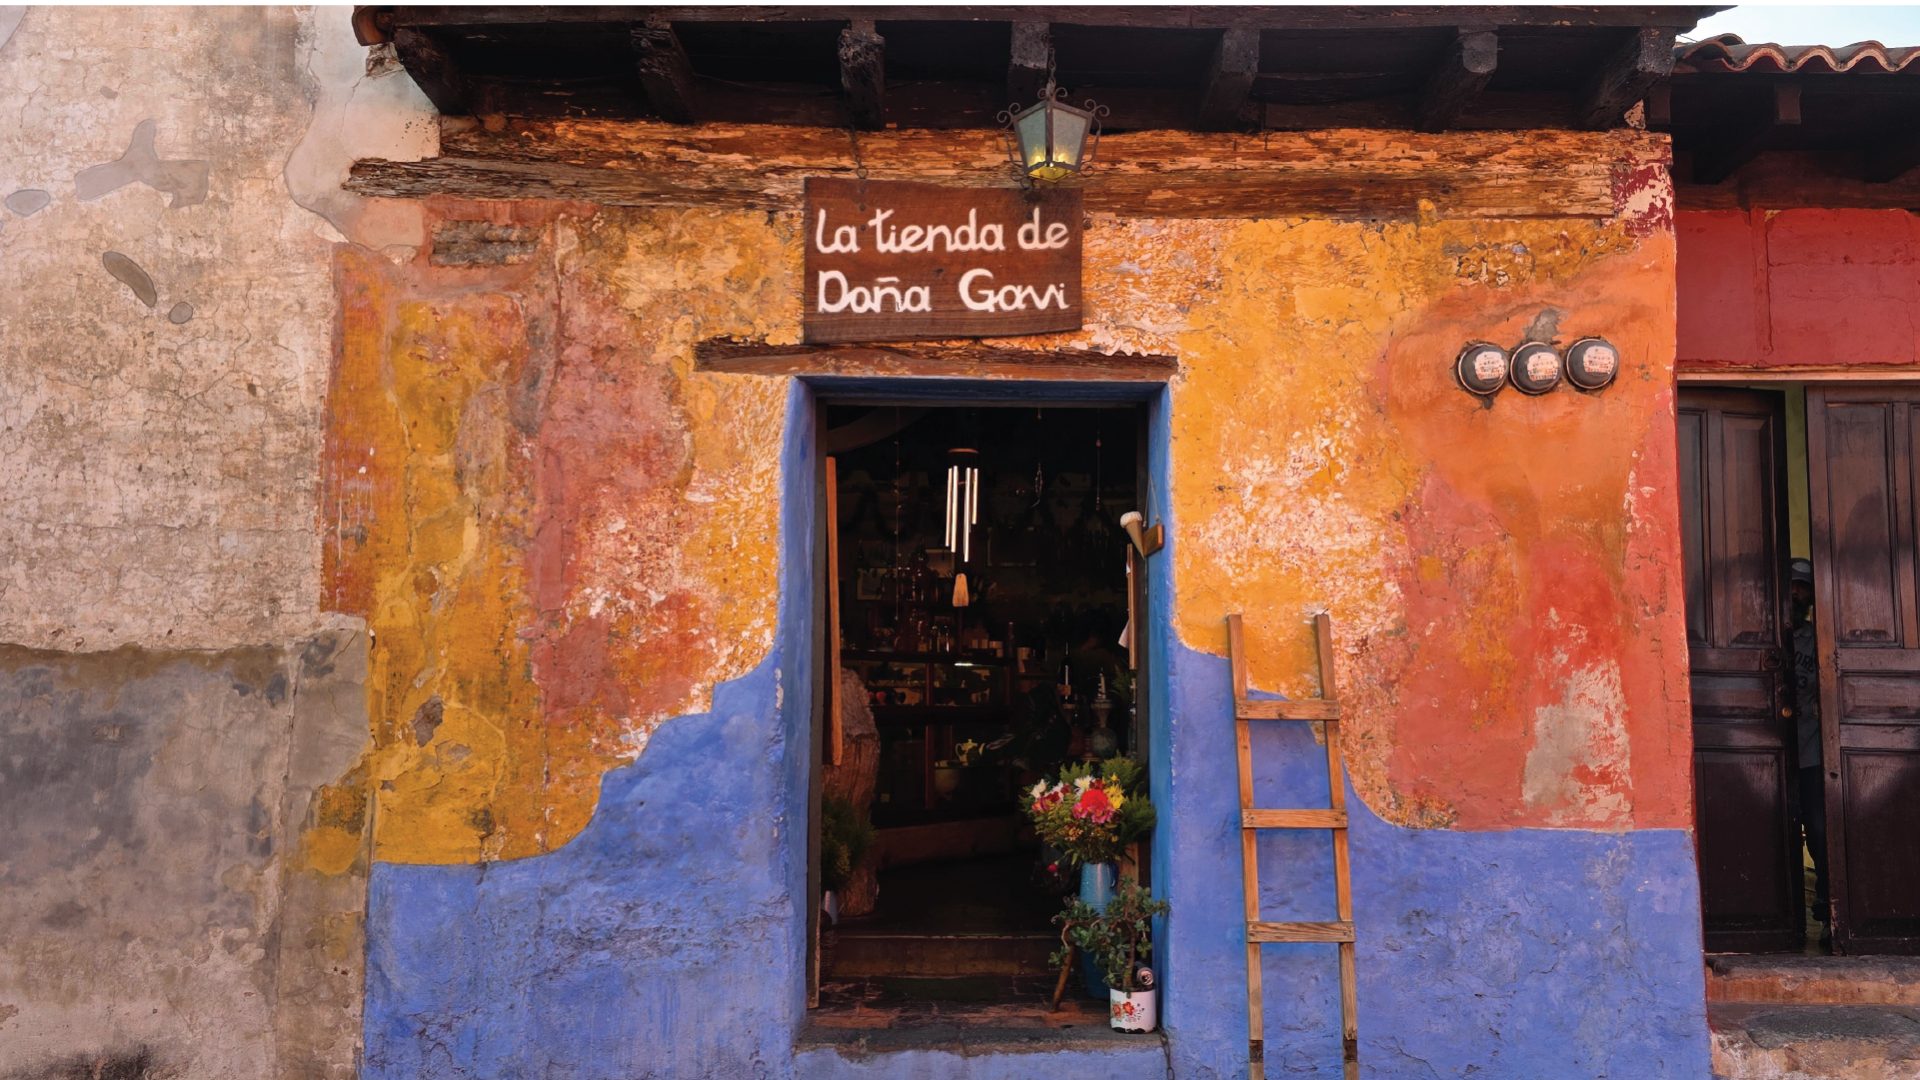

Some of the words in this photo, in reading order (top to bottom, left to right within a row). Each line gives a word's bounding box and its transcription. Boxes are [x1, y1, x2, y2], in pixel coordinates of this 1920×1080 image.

[867, 207, 1006, 254] tienda
[1016, 207, 1069, 251] de
[817, 269, 932, 314] Doña
[958, 268, 1069, 313] Gavi
